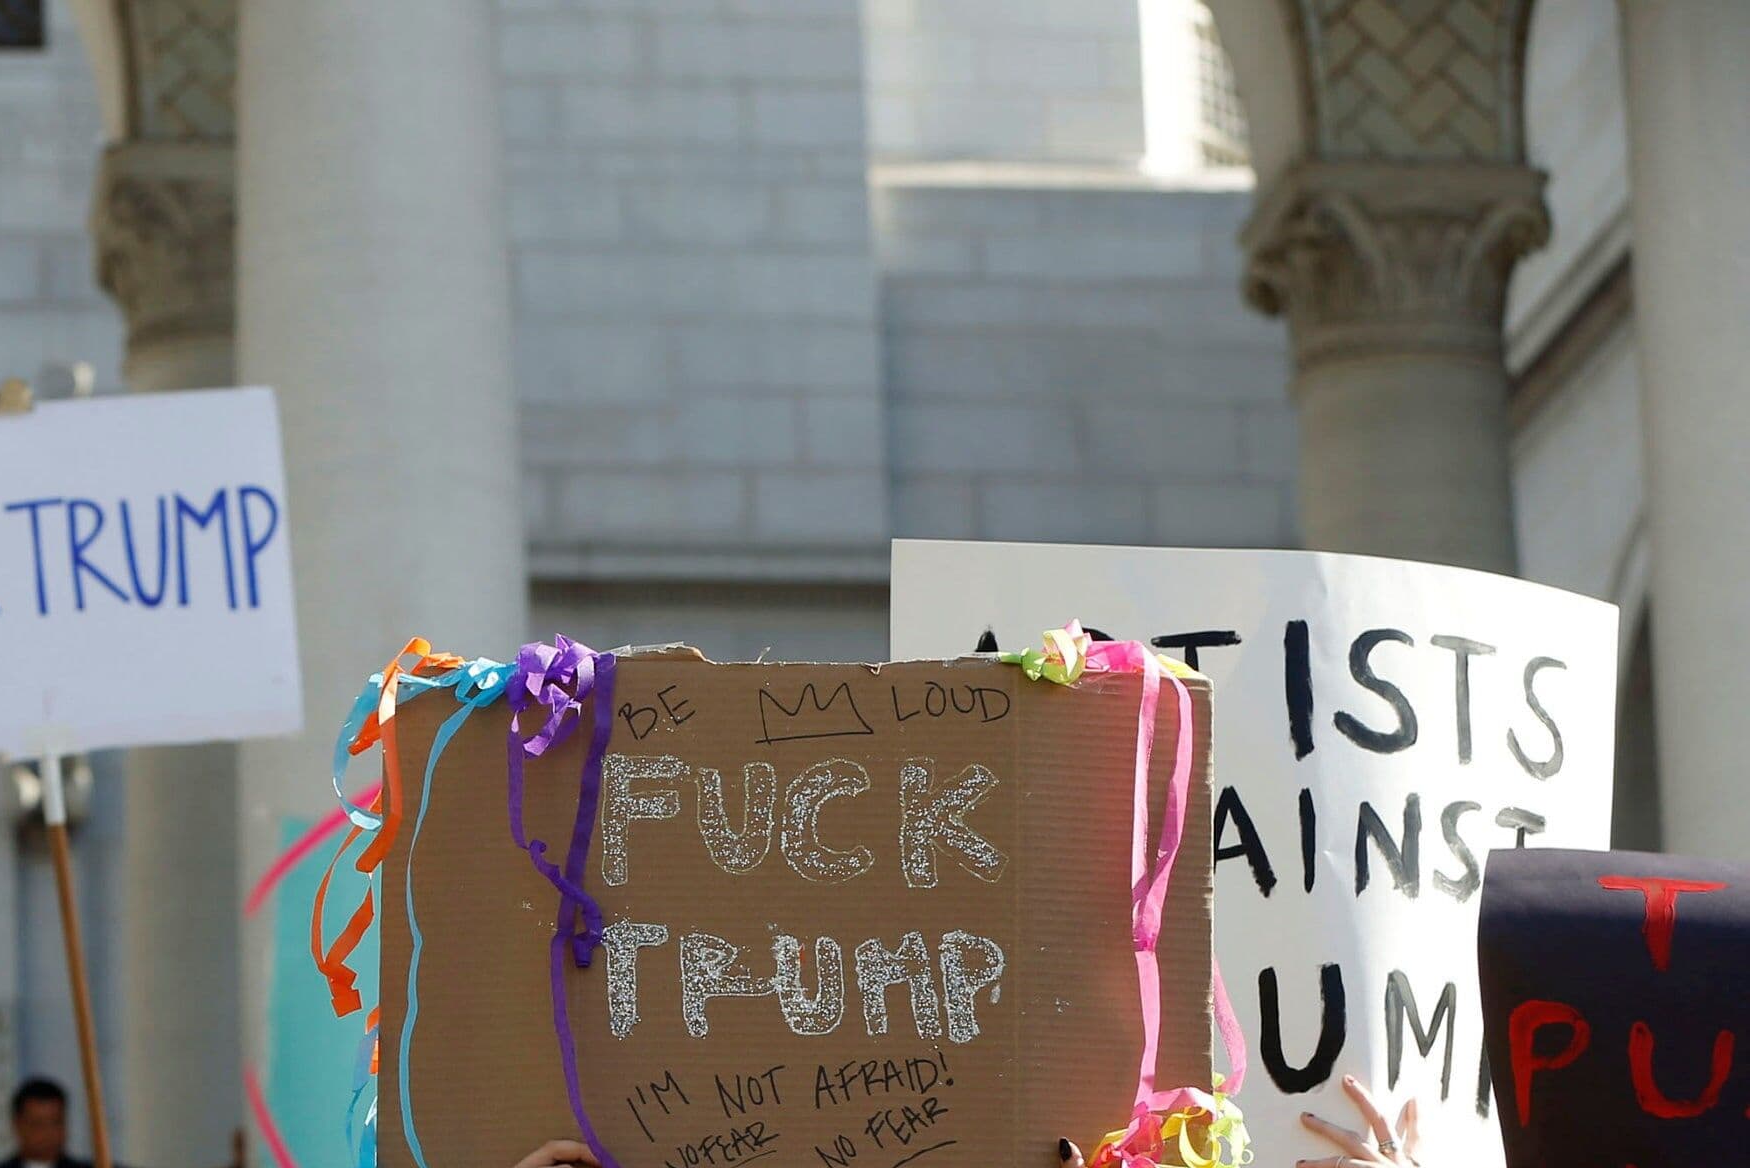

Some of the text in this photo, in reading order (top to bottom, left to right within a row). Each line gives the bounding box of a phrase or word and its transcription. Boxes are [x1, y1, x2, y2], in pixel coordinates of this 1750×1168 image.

[5, 486, 279, 612] TRUMP
[618, 681, 1011, 740] BE LOUD
[600, 752, 1009, 889] FUCK
[602, 916, 1007, 1044] TRUMP
[626, 1052, 955, 1143] I'M NOT AFRAID!
[864, 1097, 949, 1149] FEAR
[1508, 1000, 1750, 1129] PU
